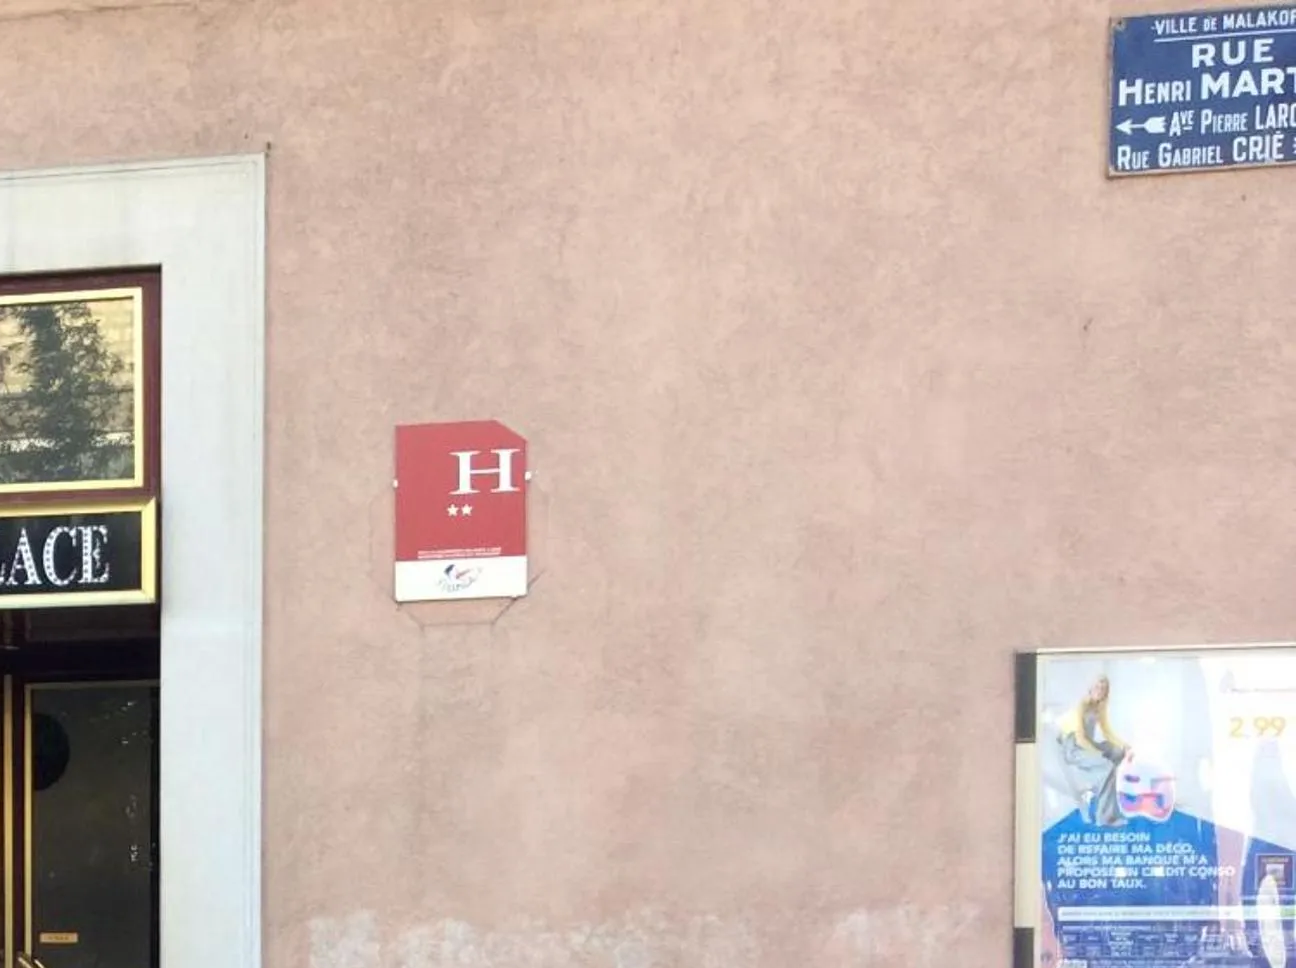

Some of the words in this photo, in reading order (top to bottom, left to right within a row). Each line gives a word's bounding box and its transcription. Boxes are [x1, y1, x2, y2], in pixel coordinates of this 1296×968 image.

[1154, 16, 1197, 35] VILLE
[1203, 17, 1217, 32] DE
[1191, 38, 1275, 68] RUE
[1118, 78, 1192, 106] HENRI
[1201, 109, 1248, 134] PIERRE
[1117, 145, 1150, 171] RUE
[1158, 143, 1224, 168] GABRIEL
[448, 448, 521, 495] H
[1104, 832, 1151, 842] BESOIN
[1131, 843, 1152, 854] MA
[1102, 855, 1123, 865] MA
[1126, 855, 1179, 865] BANQUE
[1142, 866, 1186, 877] CRDIT
[1057, 878, 1076, 889] AU
[1079, 878, 1107, 889] BON
